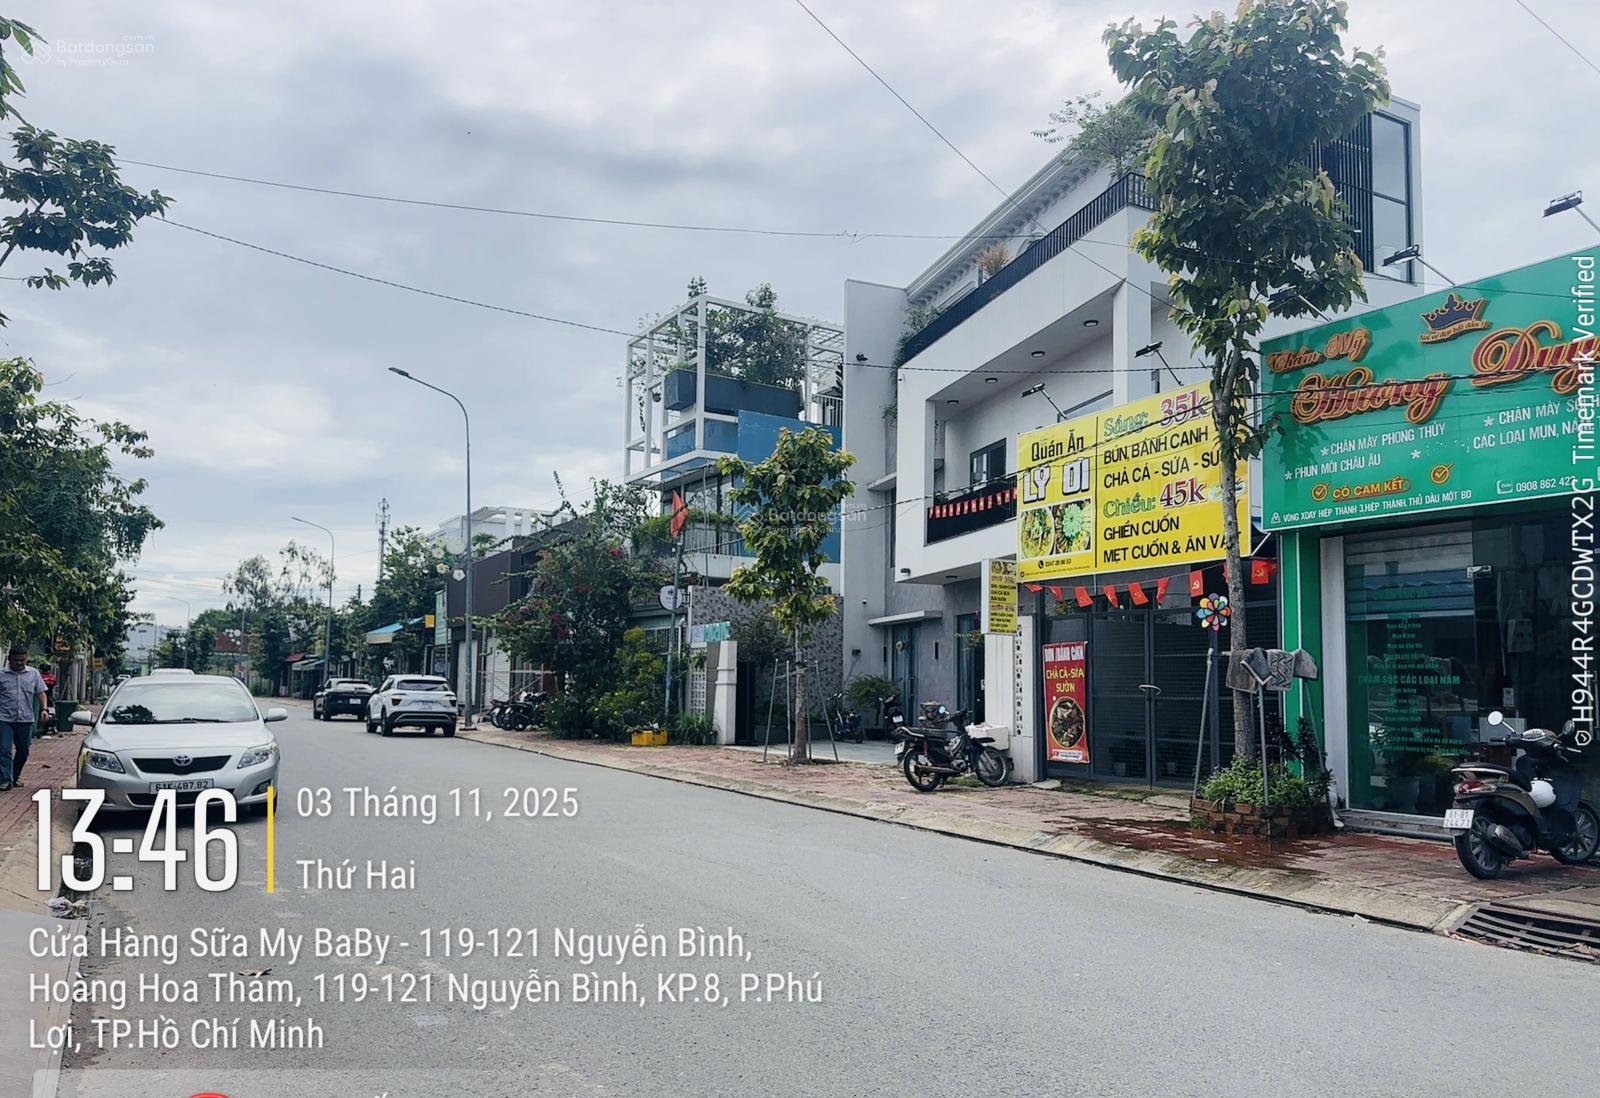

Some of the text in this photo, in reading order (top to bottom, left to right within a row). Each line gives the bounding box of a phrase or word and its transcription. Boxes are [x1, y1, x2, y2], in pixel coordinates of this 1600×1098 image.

[1291, 367, 1449, 423] Hương
[1160, 389, 1211, 428] 35k
[1499, 406, 1531, 425] CHÂN
[1535, 400, 1561, 418] MÀY
[1031, 428, 1084, 461] Quán Ăn
[1132, 437, 1167, 459] BÁNH
[1170, 426, 1209, 450] CANH
[1381, 428, 1415, 446] PHONG
[1473, 433, 1496, 450] CÁC
[1500, 429, 1525, 446] LOẠI
[1132, 462, 1151, 483] CÁ
[1294, 465, 1318, 479] PHUN
[1340, 455, 1365, 472] CHÂU
[1368, 453, 1382, 467] ÂU
[1160, 478, 1206, 510] 45k
[1332, 474, 1404, 499] CÓ CAM KẾT
[1516, 481, 1538, 492] 0908
[1540, 478, 1557, 489] 862
[1142, 513, 1179, 535] CUỐN
[1104, 547, 1128, 564] MẸT
[1131, 538, 1169, 560] CUỐN
[1171, 540, 1181, 554] &
[1185, 534, 1206, 553] ĂN
[1400, 673, 1417, 684] CÁC
